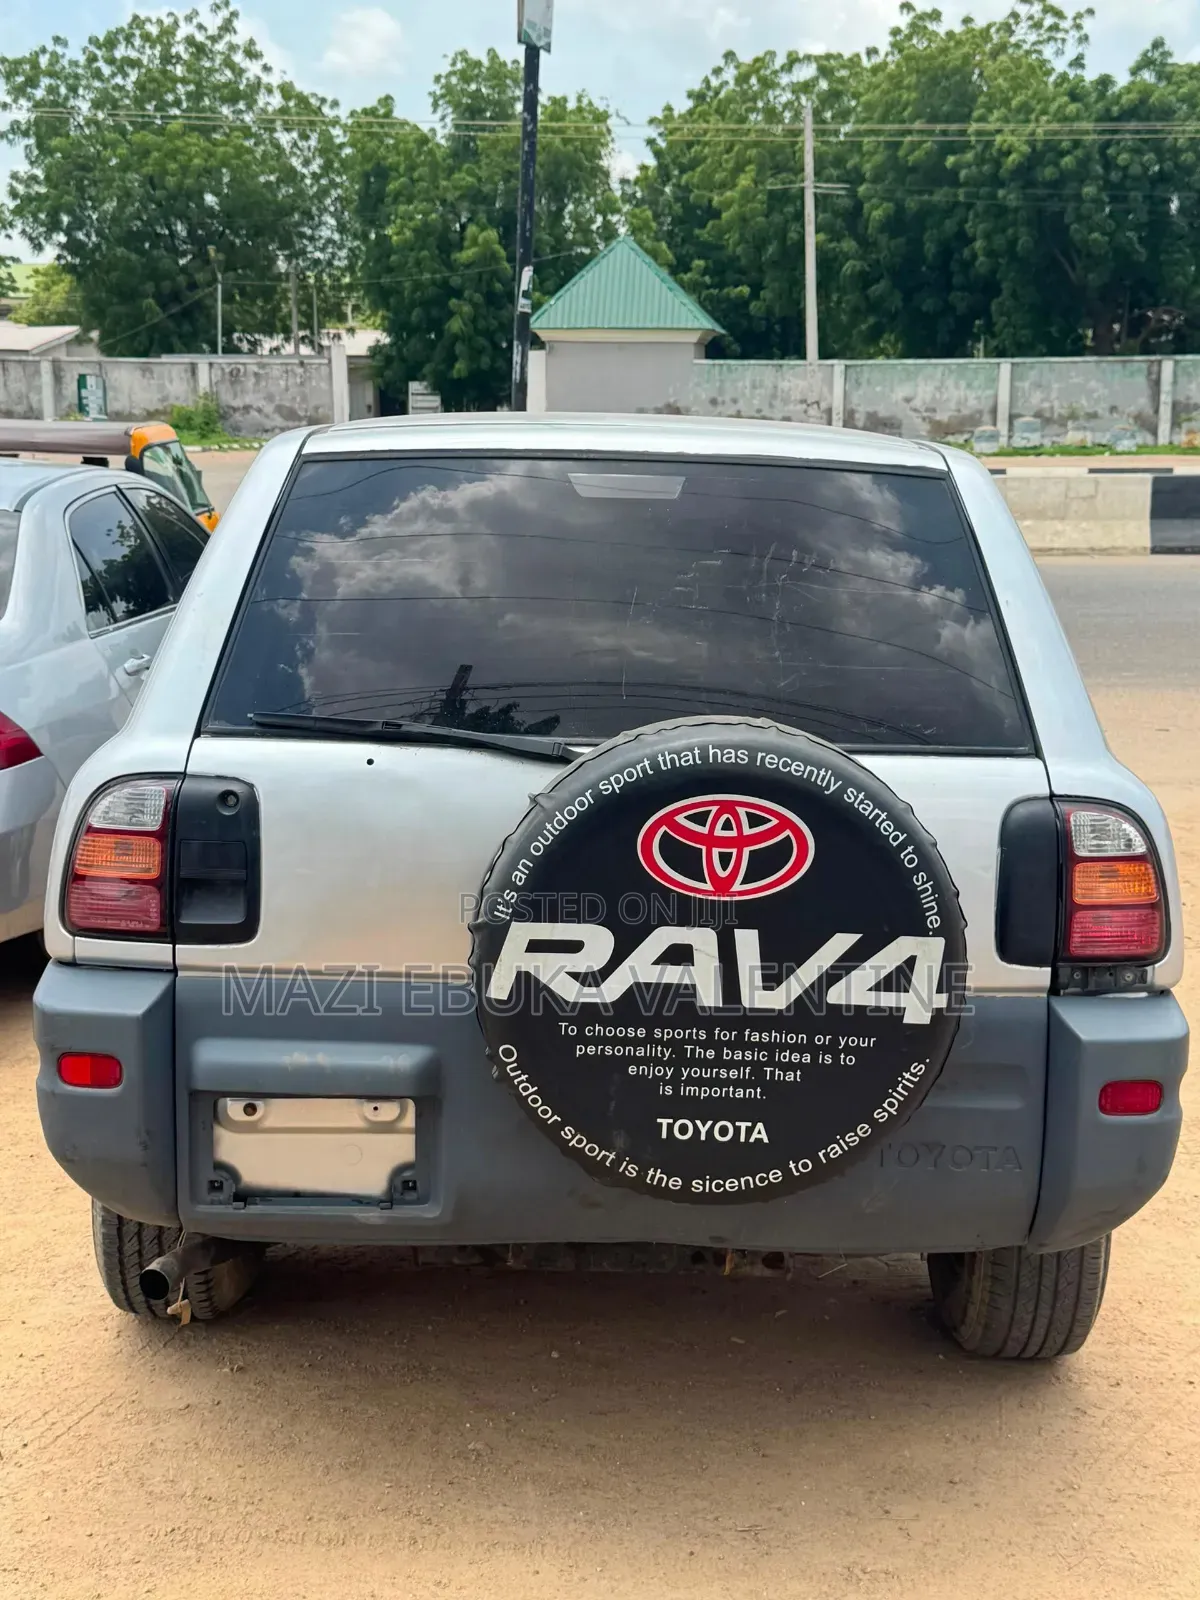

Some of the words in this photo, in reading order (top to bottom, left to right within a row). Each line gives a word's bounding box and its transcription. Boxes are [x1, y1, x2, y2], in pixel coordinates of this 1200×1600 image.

[494, 889, 518, 920] It's
[511, 858, 533, 886] an
[530, 788, 595, 856] outdoor
[598, 757, 654, 794] sport
[657, 746, 702, 771] that
[708, 744, 749, 764] has
[756, 751, 843, 795] recently
[843, 787, 908, 848] started
[900, 845, 918, 869] to
[913, 871, 941, 936] shine.
[486, 921, 949, 1025] RAV4
[558, 1022, 577, 1036] To
[585, 1023, 646, 1038] choose
[653, 1027, 707, 1041] sports
[714, 1027, 737, 1041] for
[744, 1028, 807, 1044] fashion
[814, 1034, 832, 1045] or
[839, 1035, 877, 1049] your
[576, 1044, 676, 1060] personality.
[684, 1045, 715, 1059] The
[723, 1047, 768, 1061] basic
[775, 1049, 811, 1064] idea
[818, 1051, 832, 1065] is
[840, 1052, 856, 1066] to
[628, 1063, 674, 1079] enjoy
[681, 1066, 755, 1080] yourself.
[764, 1067, 802, 1082] That
[659, 1082, 673, 1096] is
[680, 1083, 766, 1100] important.
[499, 1044, 561, 1125] Outdoor
[560, 1125, 616, 1167] sport
[618, 1157, 639, 1177] is
[646, 1168, 682, 1190] the
[691, 1169, 783, 1193] sicence
[789, 1158, 812, 1176] to
[817, 1122, 872, 1164] raise
[873, 1057, 930, 1123] spirits.
[657, 1118, 769, 1143] TOYOTA
[877, 1141, 1023, 1172] TOYOTA
